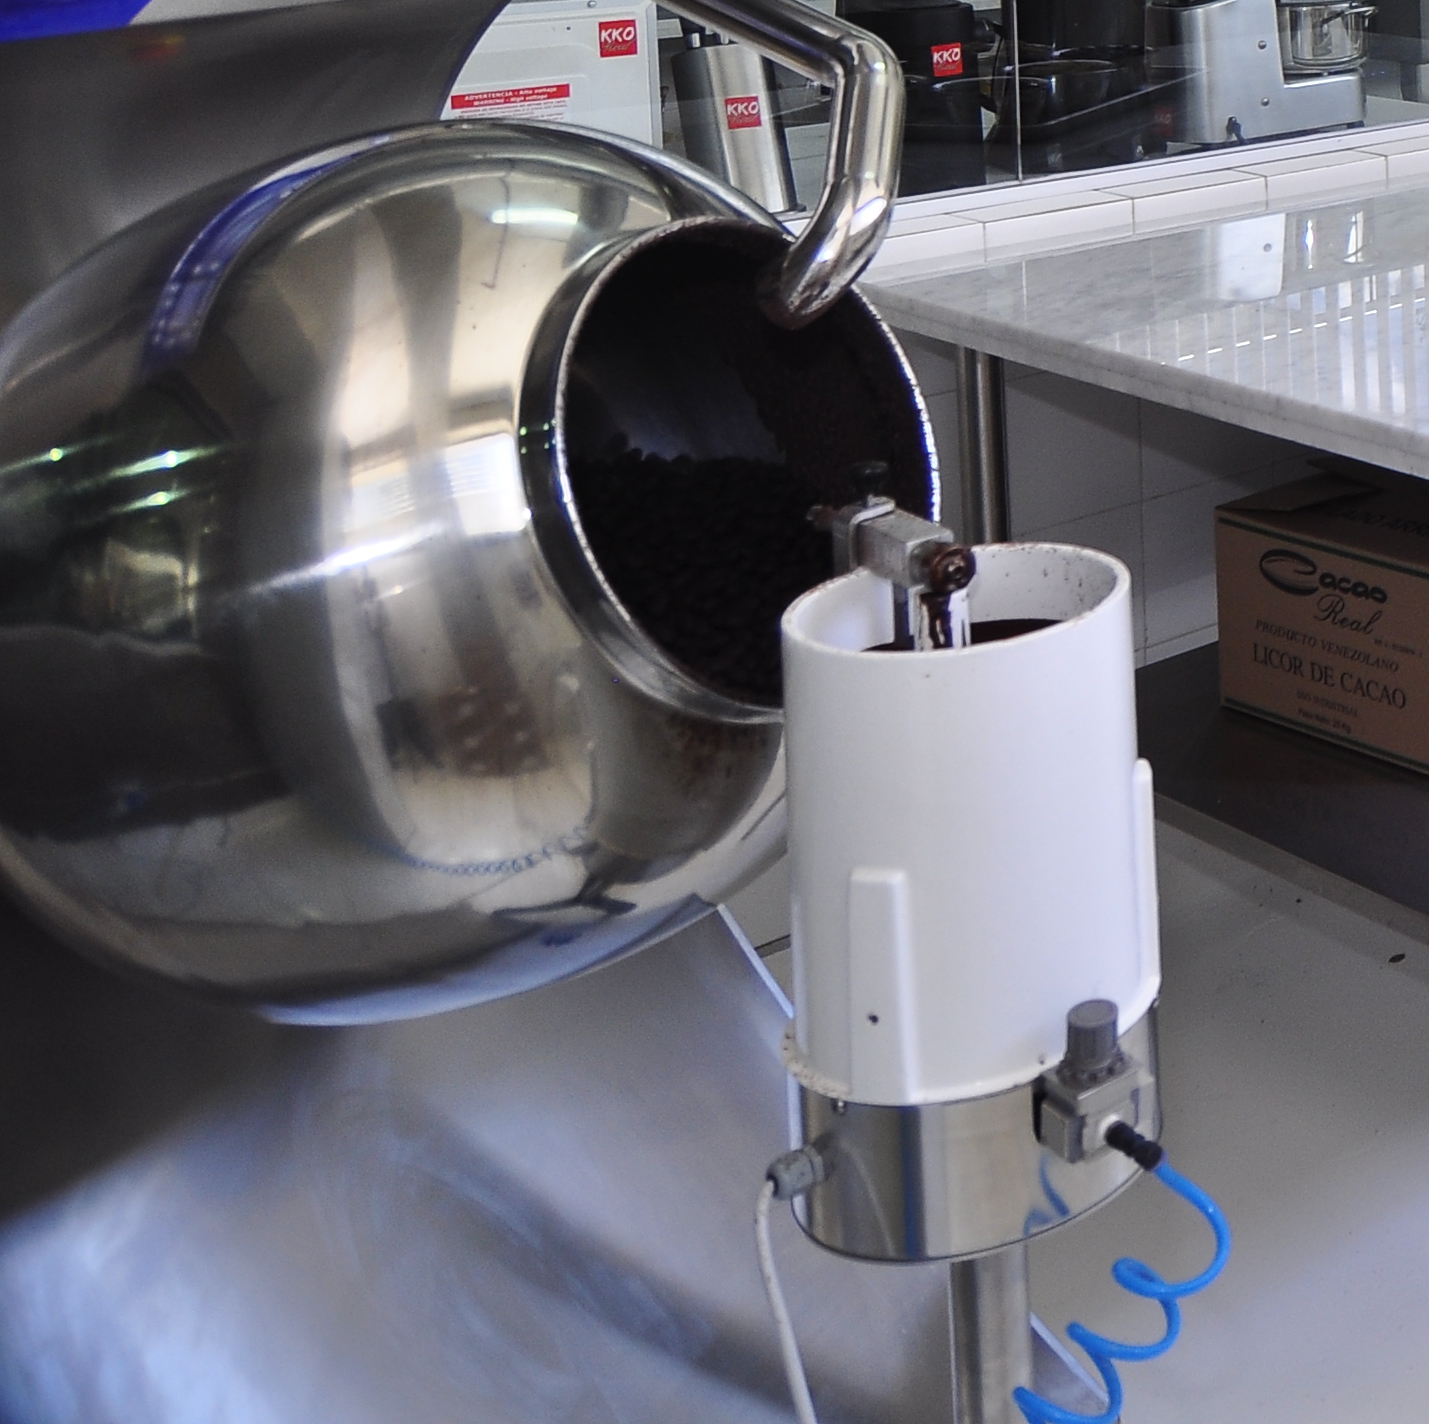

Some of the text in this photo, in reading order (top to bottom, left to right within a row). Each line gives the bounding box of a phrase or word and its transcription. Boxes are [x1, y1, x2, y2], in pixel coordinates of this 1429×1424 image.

[601, 26, 635, 44] KKO
[933, 48, 961, 64] KKO
[727, 101, 759, 117] KKO
[1259, 548, 1387, 603] Cacao
[1314, 594, 1383, 635] Real
[1256, 619, 1317, 647] PRODUCTO
[1321, 638, 1399, 672] VENEZOLANO
[1253, 643, 1406, 709] LICOR DE CACAO
